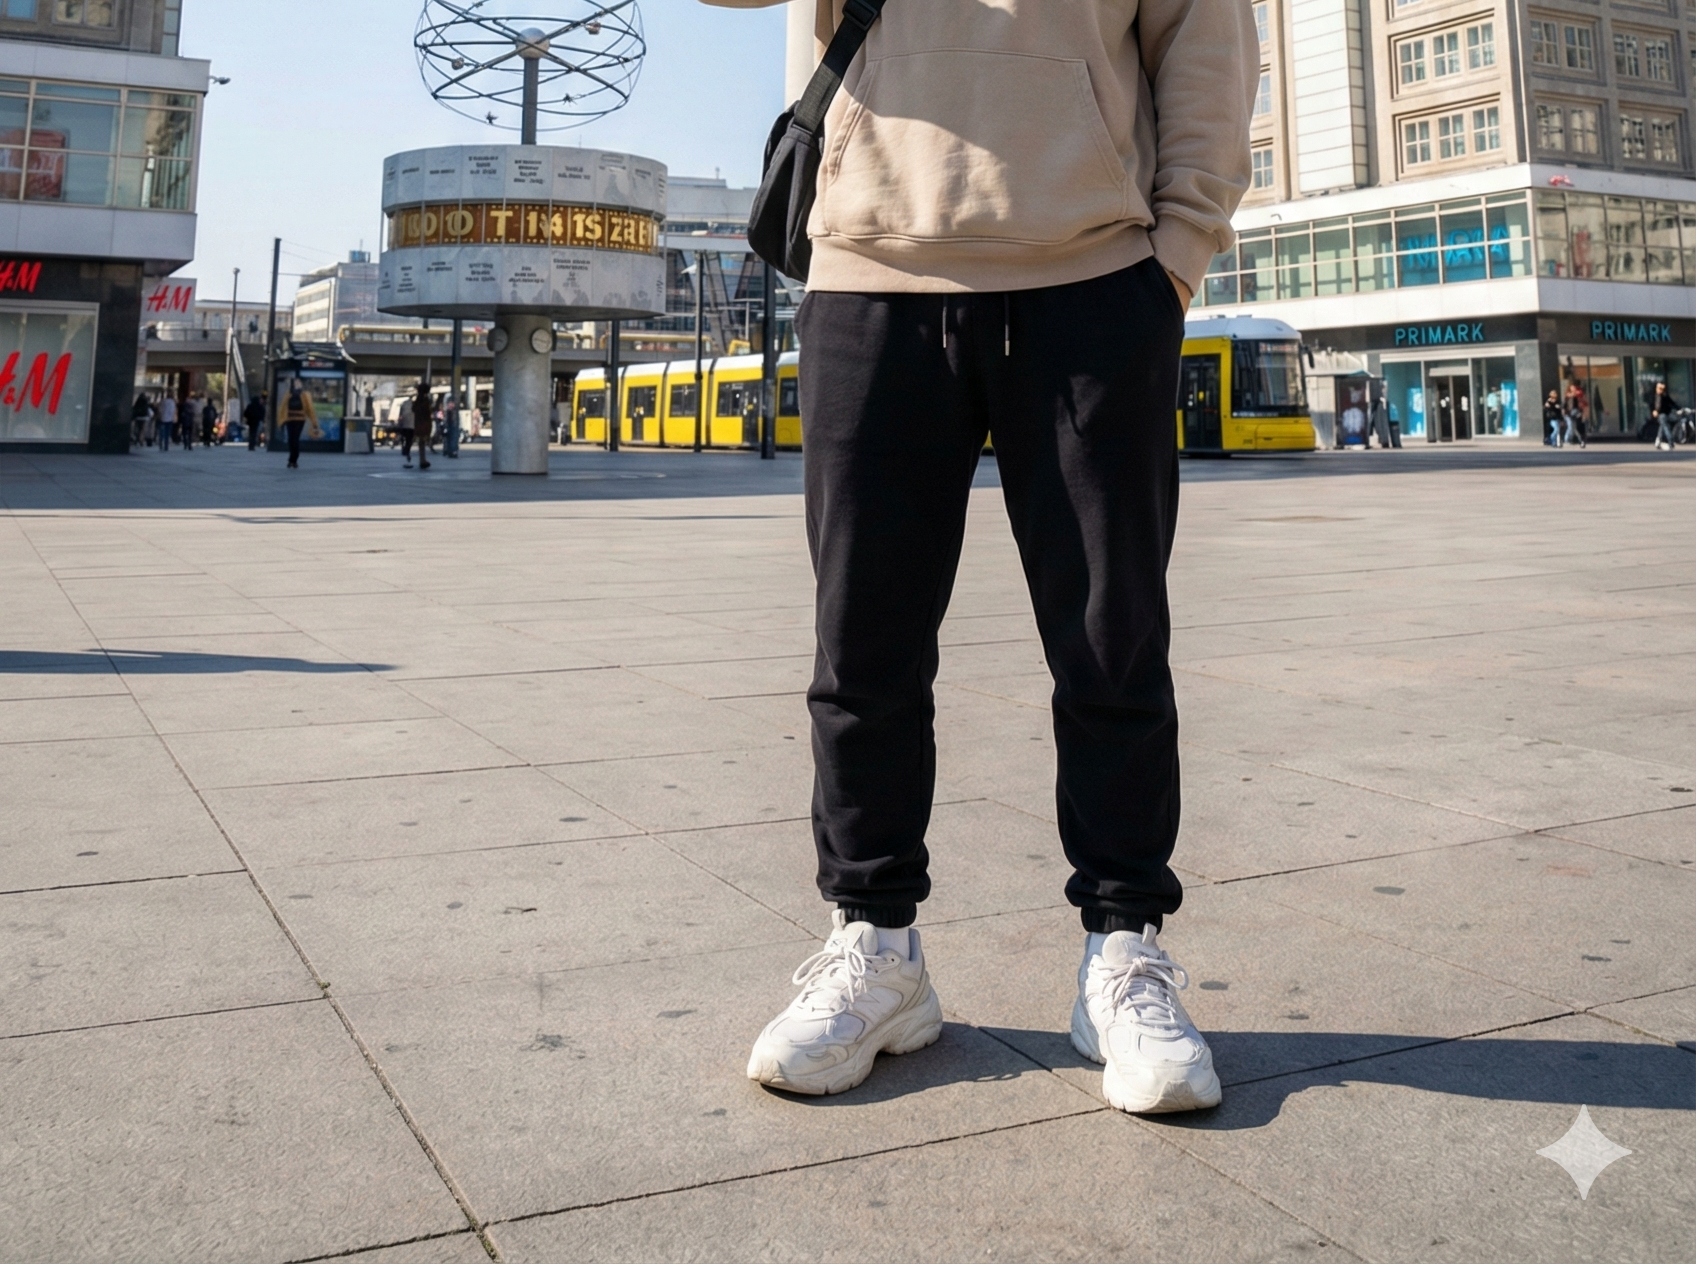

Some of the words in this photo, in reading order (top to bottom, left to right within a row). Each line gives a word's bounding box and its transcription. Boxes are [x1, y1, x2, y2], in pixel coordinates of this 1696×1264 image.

[146, 284, 192, 313] H&M
[1394, 322, 1484, 346] PRIMARK
[1591, 320, 1673, 343] PRIMARK
